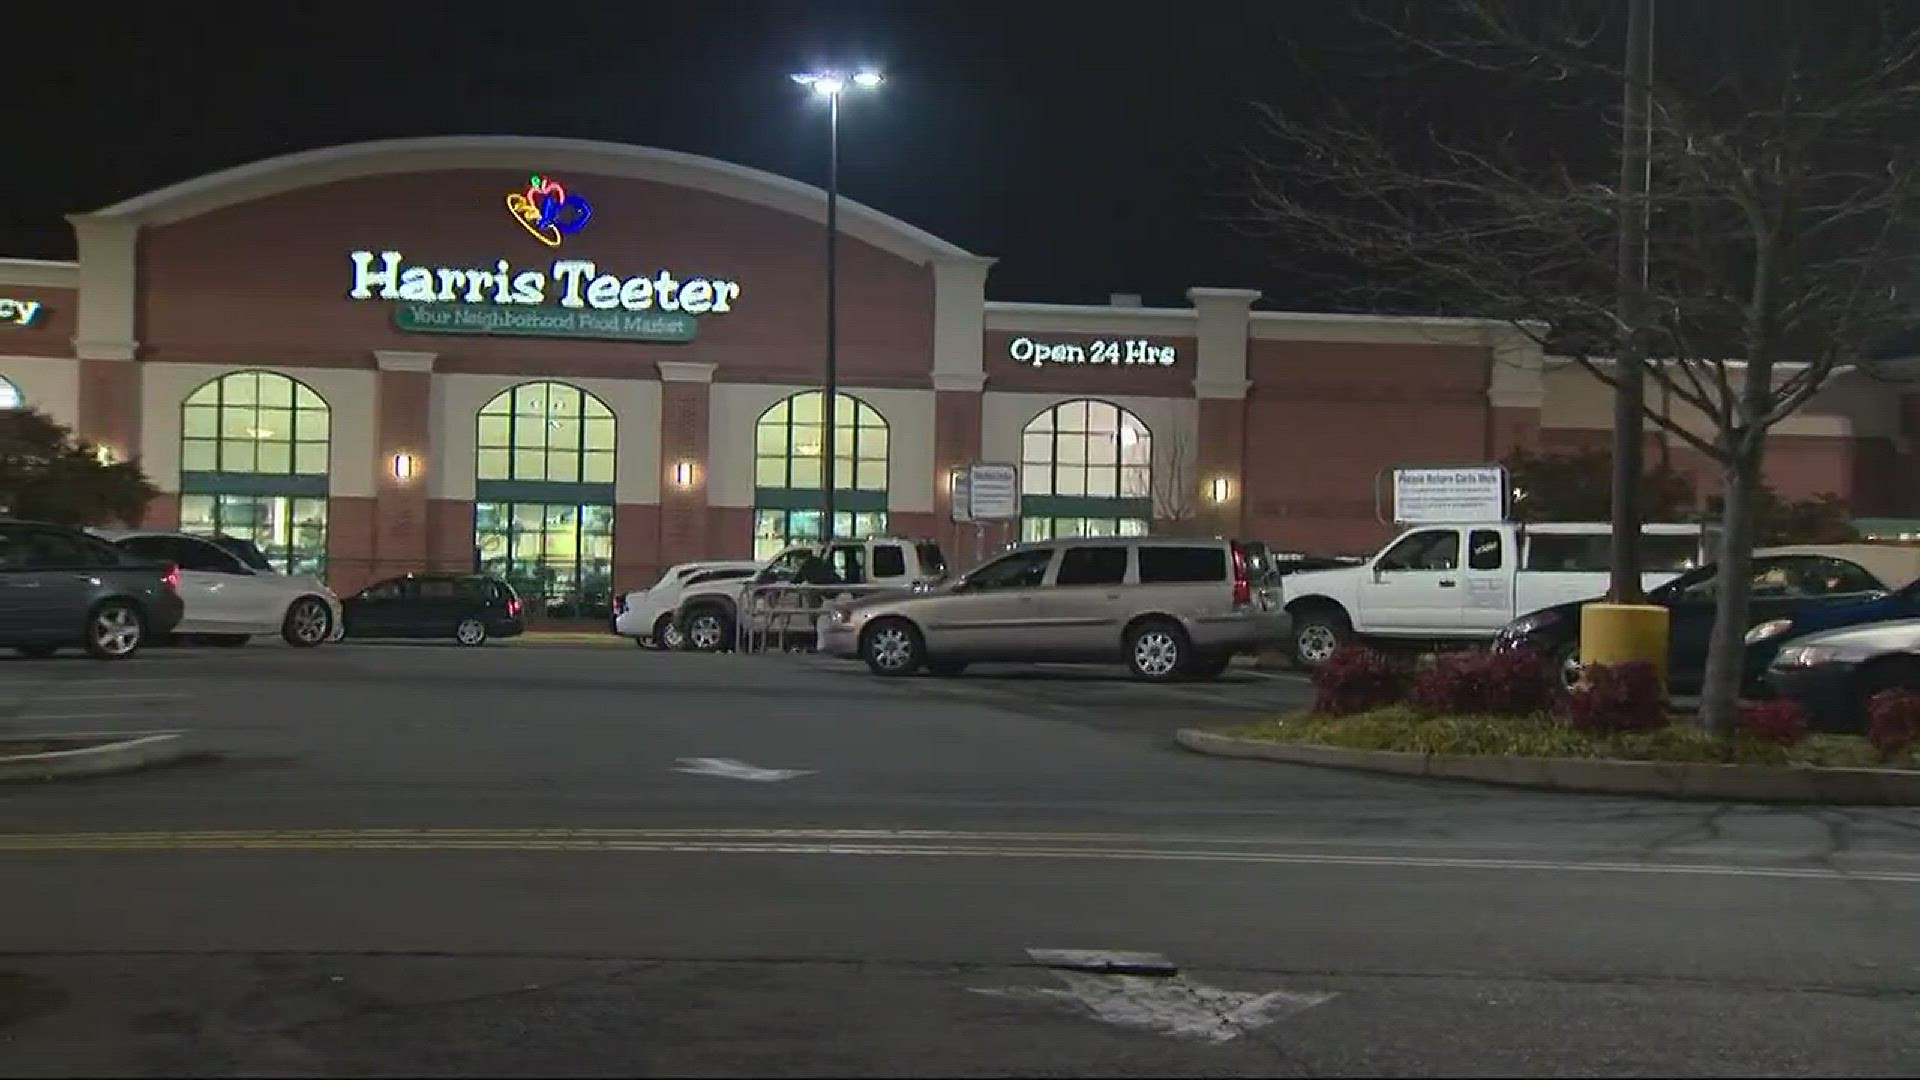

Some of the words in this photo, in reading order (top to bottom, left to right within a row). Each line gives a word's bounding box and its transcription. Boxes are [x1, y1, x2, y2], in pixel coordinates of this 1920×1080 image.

[350, 250, 545, 304] Harris
[553, 259, 740, 313] Teeter
[410, 306, 452, 324] Your
[454, 309, 575, 331] Neighborhood
[580, 312, 620, 331] Food
[624, 316, 684, 333] Market
[1010, 337, 1086, 367] Open
[1090, 340, 1120, 365] 24
[1125, 340, 1176, 366] Hrs
